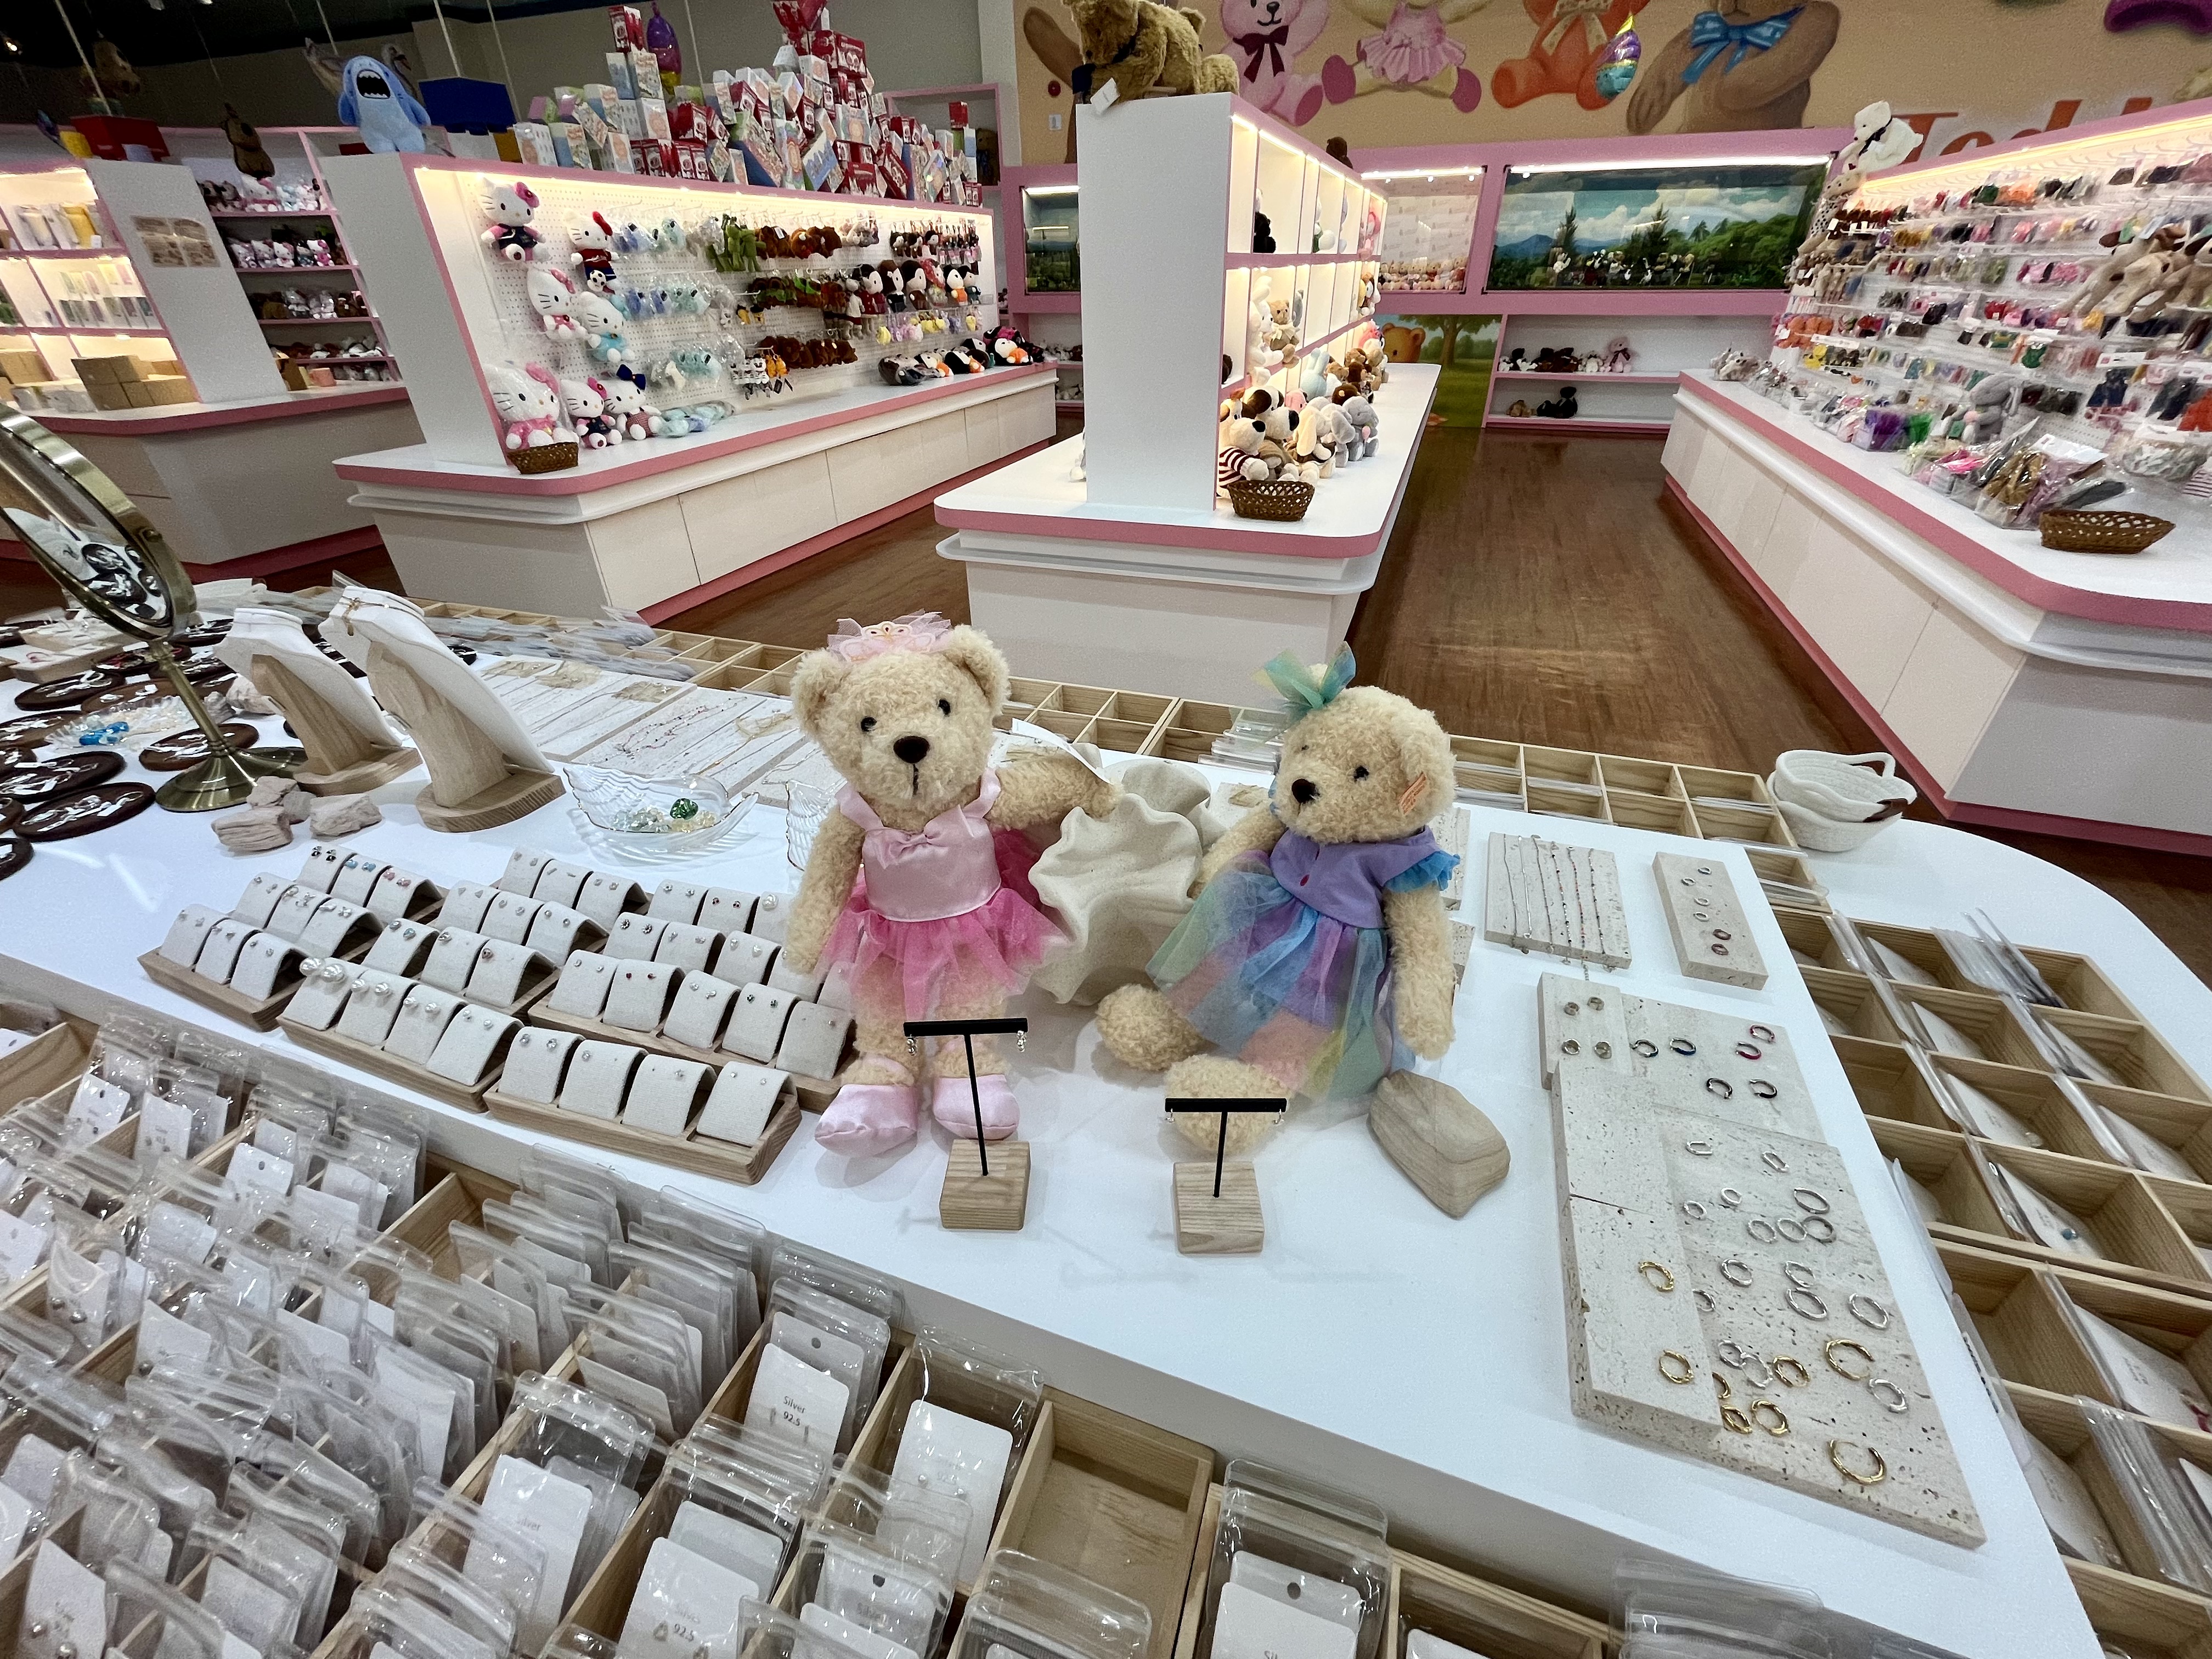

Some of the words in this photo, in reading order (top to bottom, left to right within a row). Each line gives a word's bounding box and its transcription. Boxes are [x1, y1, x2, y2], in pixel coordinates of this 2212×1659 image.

[783, 1395, 806, 1414] Silver
[783, 1411, 800, 1426] 92.5
[674, 1623, 695, 1643] 92.5
